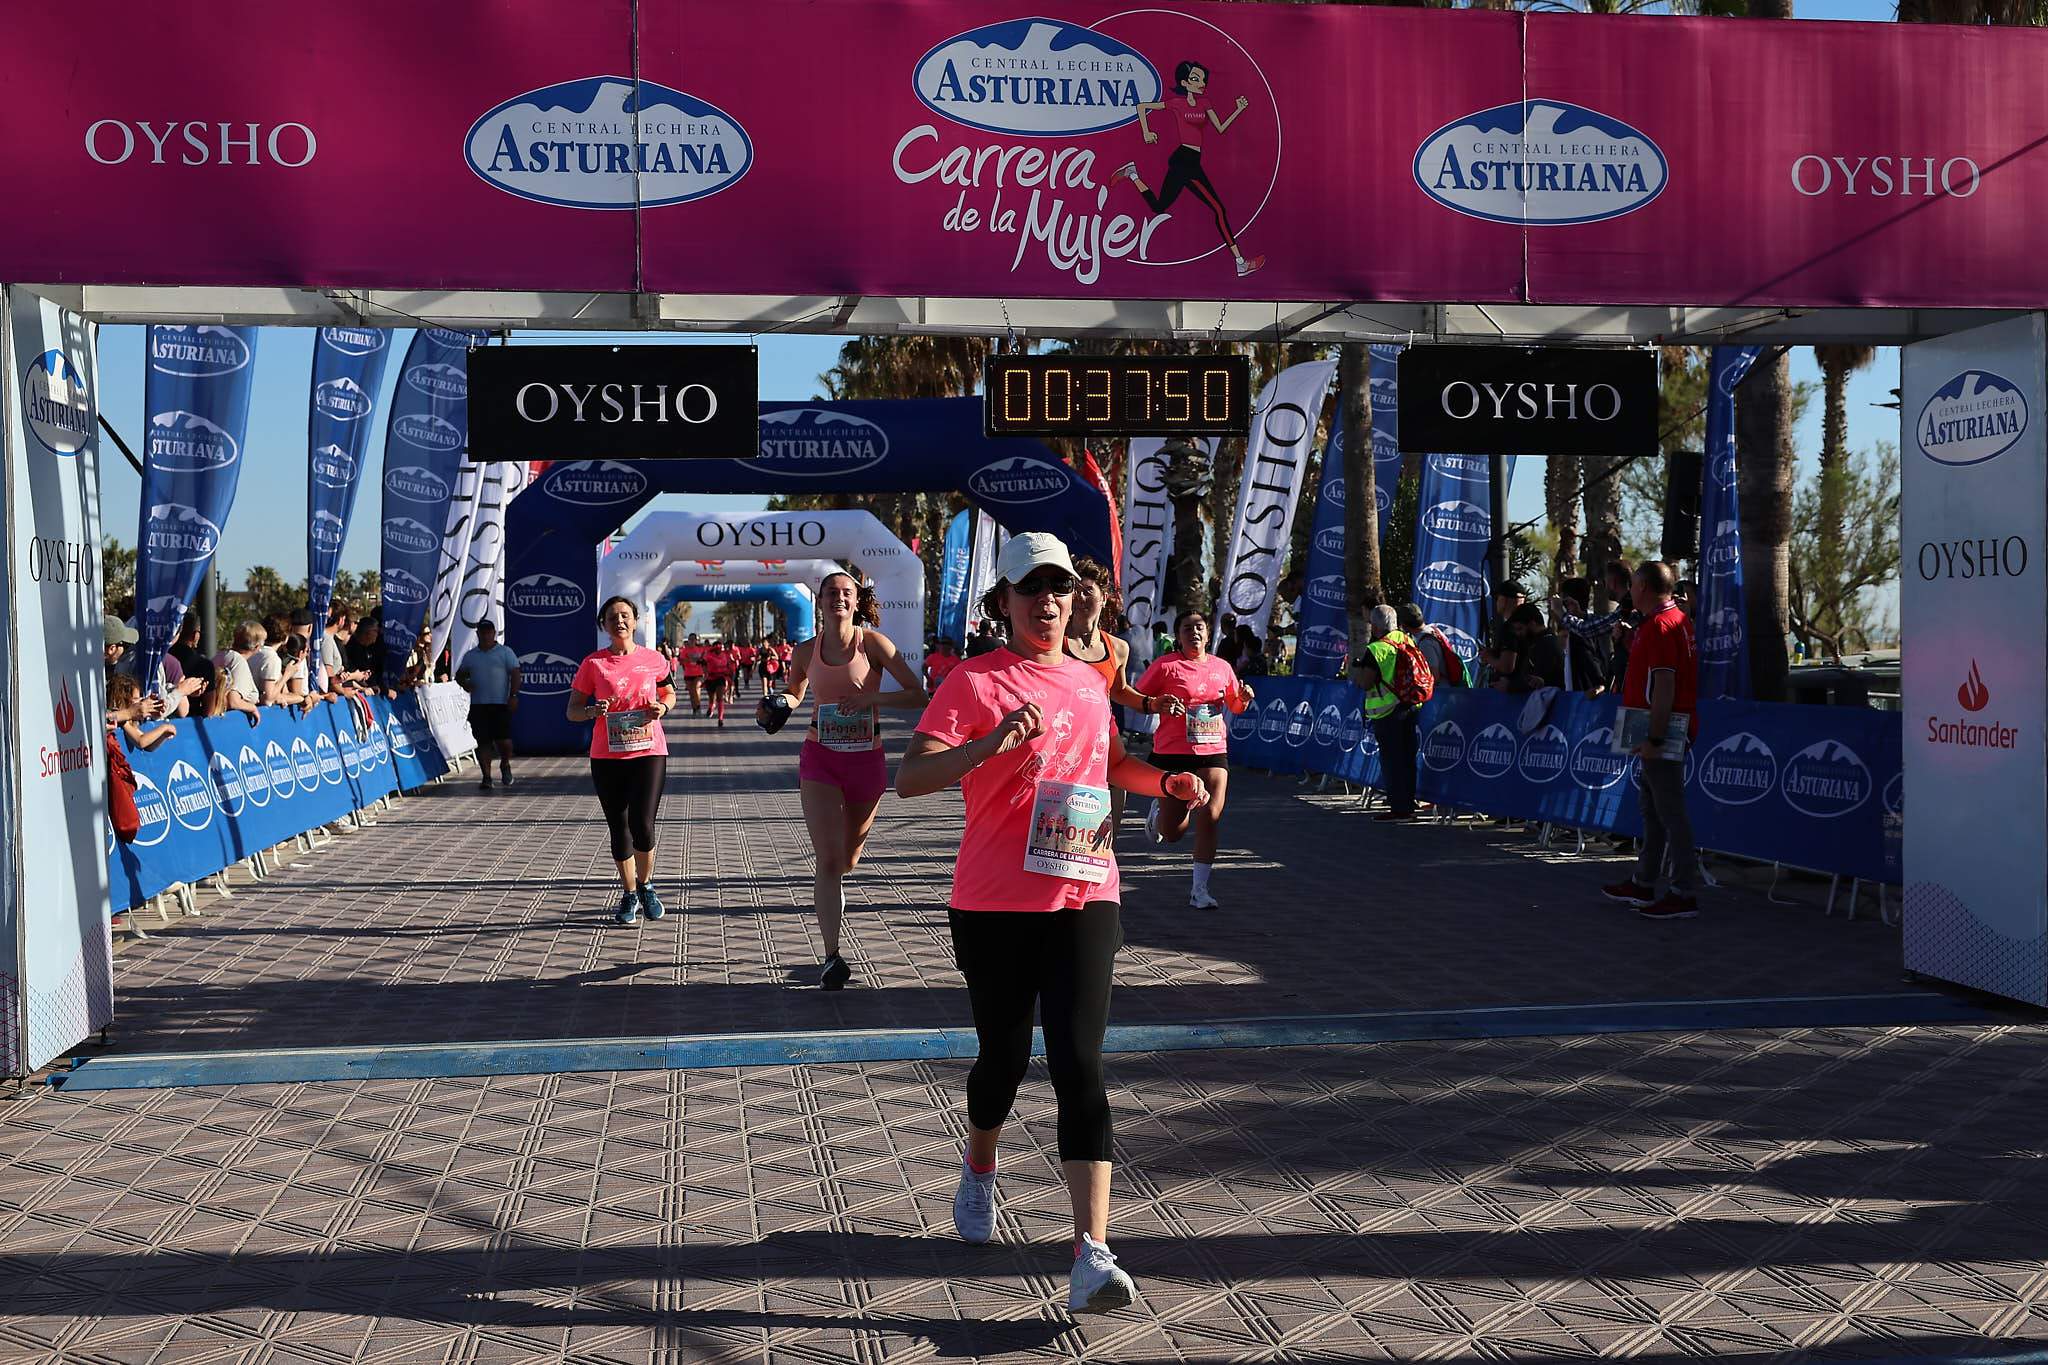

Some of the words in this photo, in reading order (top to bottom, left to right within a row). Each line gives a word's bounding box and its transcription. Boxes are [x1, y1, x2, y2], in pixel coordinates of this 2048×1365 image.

[971, 57, 1049, 71] CENTRAL
[1057, 60, 1135, 73] LECHERA
[933, 58, 1142, 107] ASTURIANA
[532, 121, 621, 135] CENTRAL
[85, 119, 317, 168] OYSHO
[487, 123, 731, 174] ASTURIANA
[892, 124, 1097, 190] Carrera
[1473, 142, 1555, 154] CENTRAL
[1561, 144, 1640, 156] LECHERA
[1433, 144, 1649, 193] ASTURIANA
[1792, 154, 1980, 198] OYSHO
[943, 187, 980, 233] de
[989, 188, 1016, 233] la
[1011, 185, 1172, 285] Mujer
[30, 378, 89, 435] ASTURIANA
[515, 382, 718, 424] OYSHO
[1005, 369, 1229, 421] 00:37:50
[1441, 381, 1622, 421] OYSHO
[1939, 404, 1974, 417] CENTRAL
[1976, 396, 2016, 410] LECHERA
[1923, 409, 2020, 447] ASTURIANA
[152, 438, 226, 462] STURIANA
[761, 439, 877, 459] STURIANA
[550, 475, 639, 493] ASTURIANA
[977, 476, 1064, 493] ASTURIANA
[1228, 402, 1308, 615] OYSHO
[696, 521, 826, 547] OYSHO
[29, 536, 94, 585] OYSHO
[619, 552, 658, 561] OYSHO
[862, 547, 900, 557] OYSHO
[1918, 536, 2028, 581] OYSHO
[510, 589, 580, 607] ASTURIANA
[882, 600, 919, 609] OYSHO
[520, 672, 577, 684] TURIAN
[1006, 690, 1047, 703] OSHO
[1928, 716, 2019, 749] Santander
[40, 744, 94, 778] Santander
[1573, 748, 1622, 775] ASTURIANA
[1704, 757, 1769, 788] ASTURIANA
[1786, 763, 1860, 801] ASTURIANA
[138, 801, 168, 826] URIANA
[1065, 825, 1097, 845] 016
[1033, 848, 1059, 859] CARRERA
[1059, 852, 1068, 860] DE
[1036, 860, 1069, 872] OYSHO
